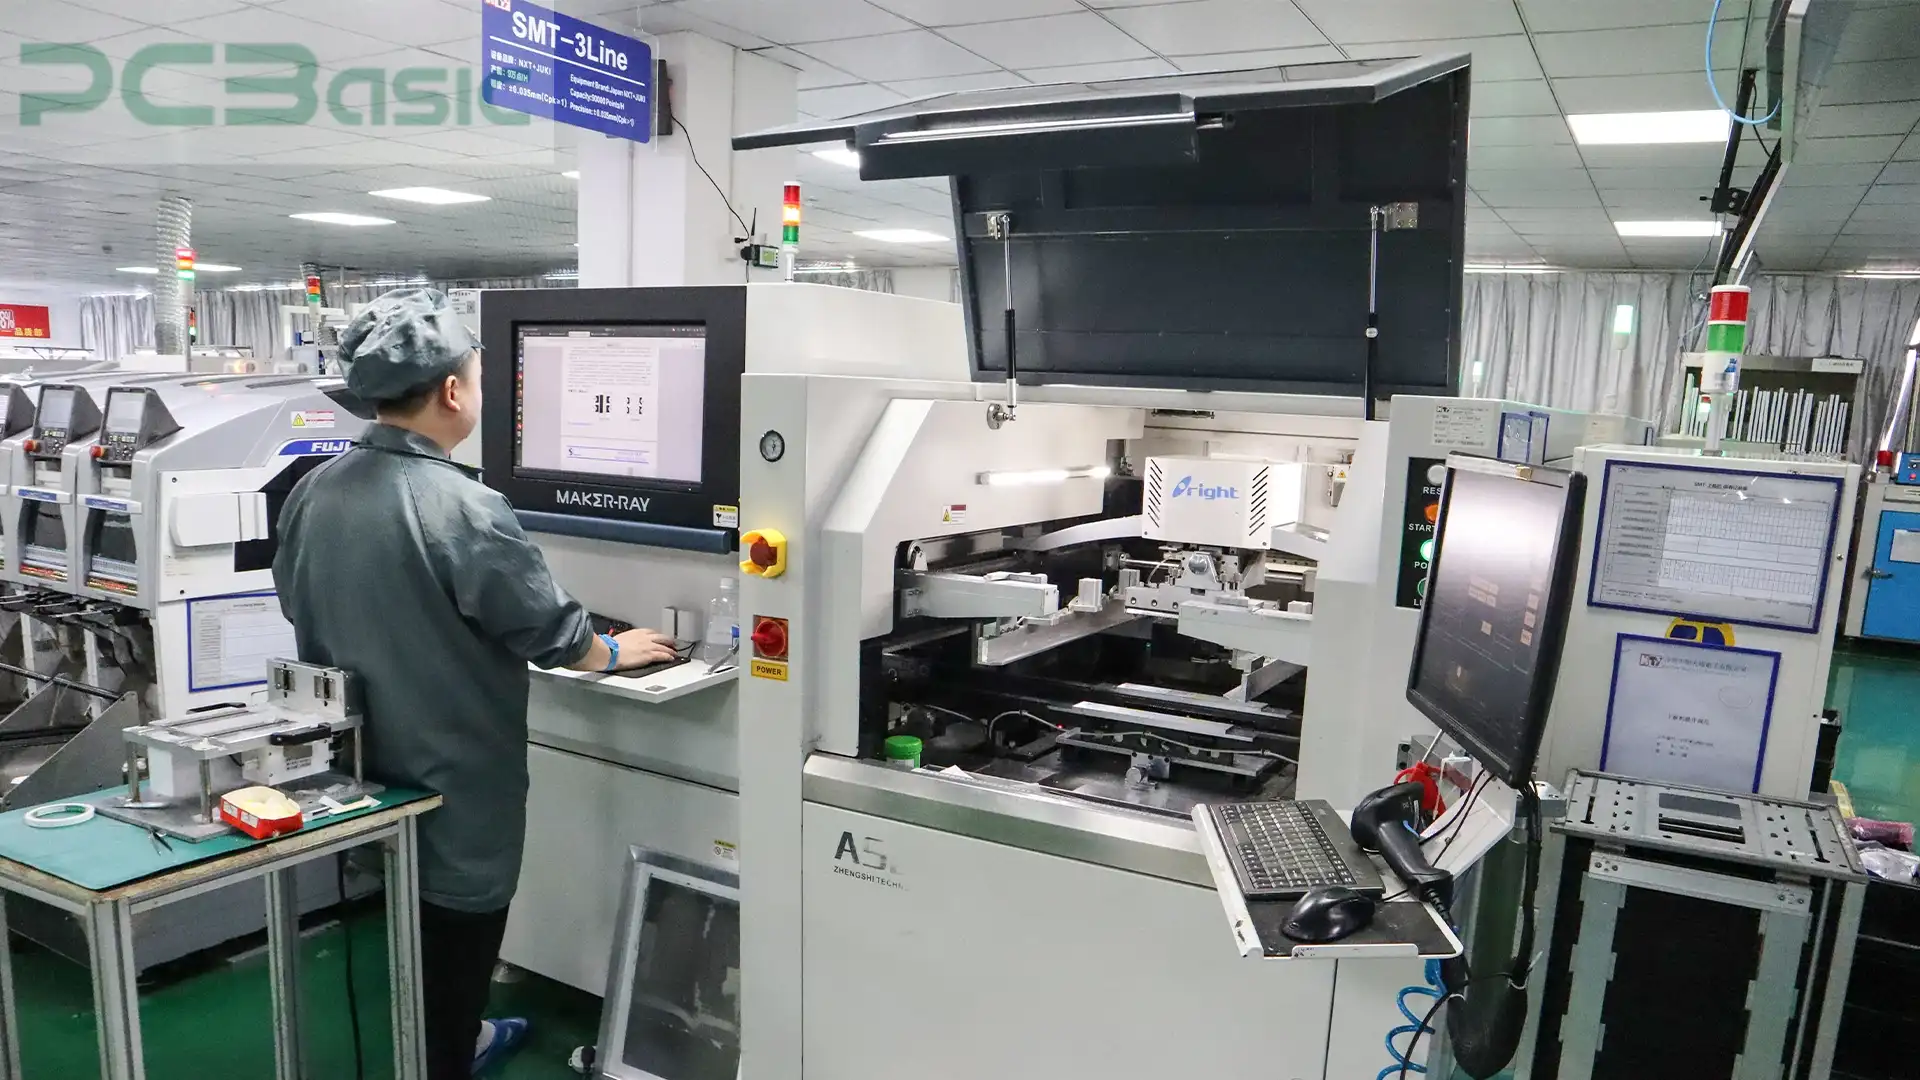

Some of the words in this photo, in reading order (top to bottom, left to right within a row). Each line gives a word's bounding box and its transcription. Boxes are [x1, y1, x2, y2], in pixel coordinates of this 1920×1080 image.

[511, 10, 629, 71] SMT-3Line
[1422, 486, 1441, 495] RES
[1414, 561, 1428, 570] PO
[756, 665, 782, 676] POWER
[833, 865, 875, 883] ZHENGSHI
